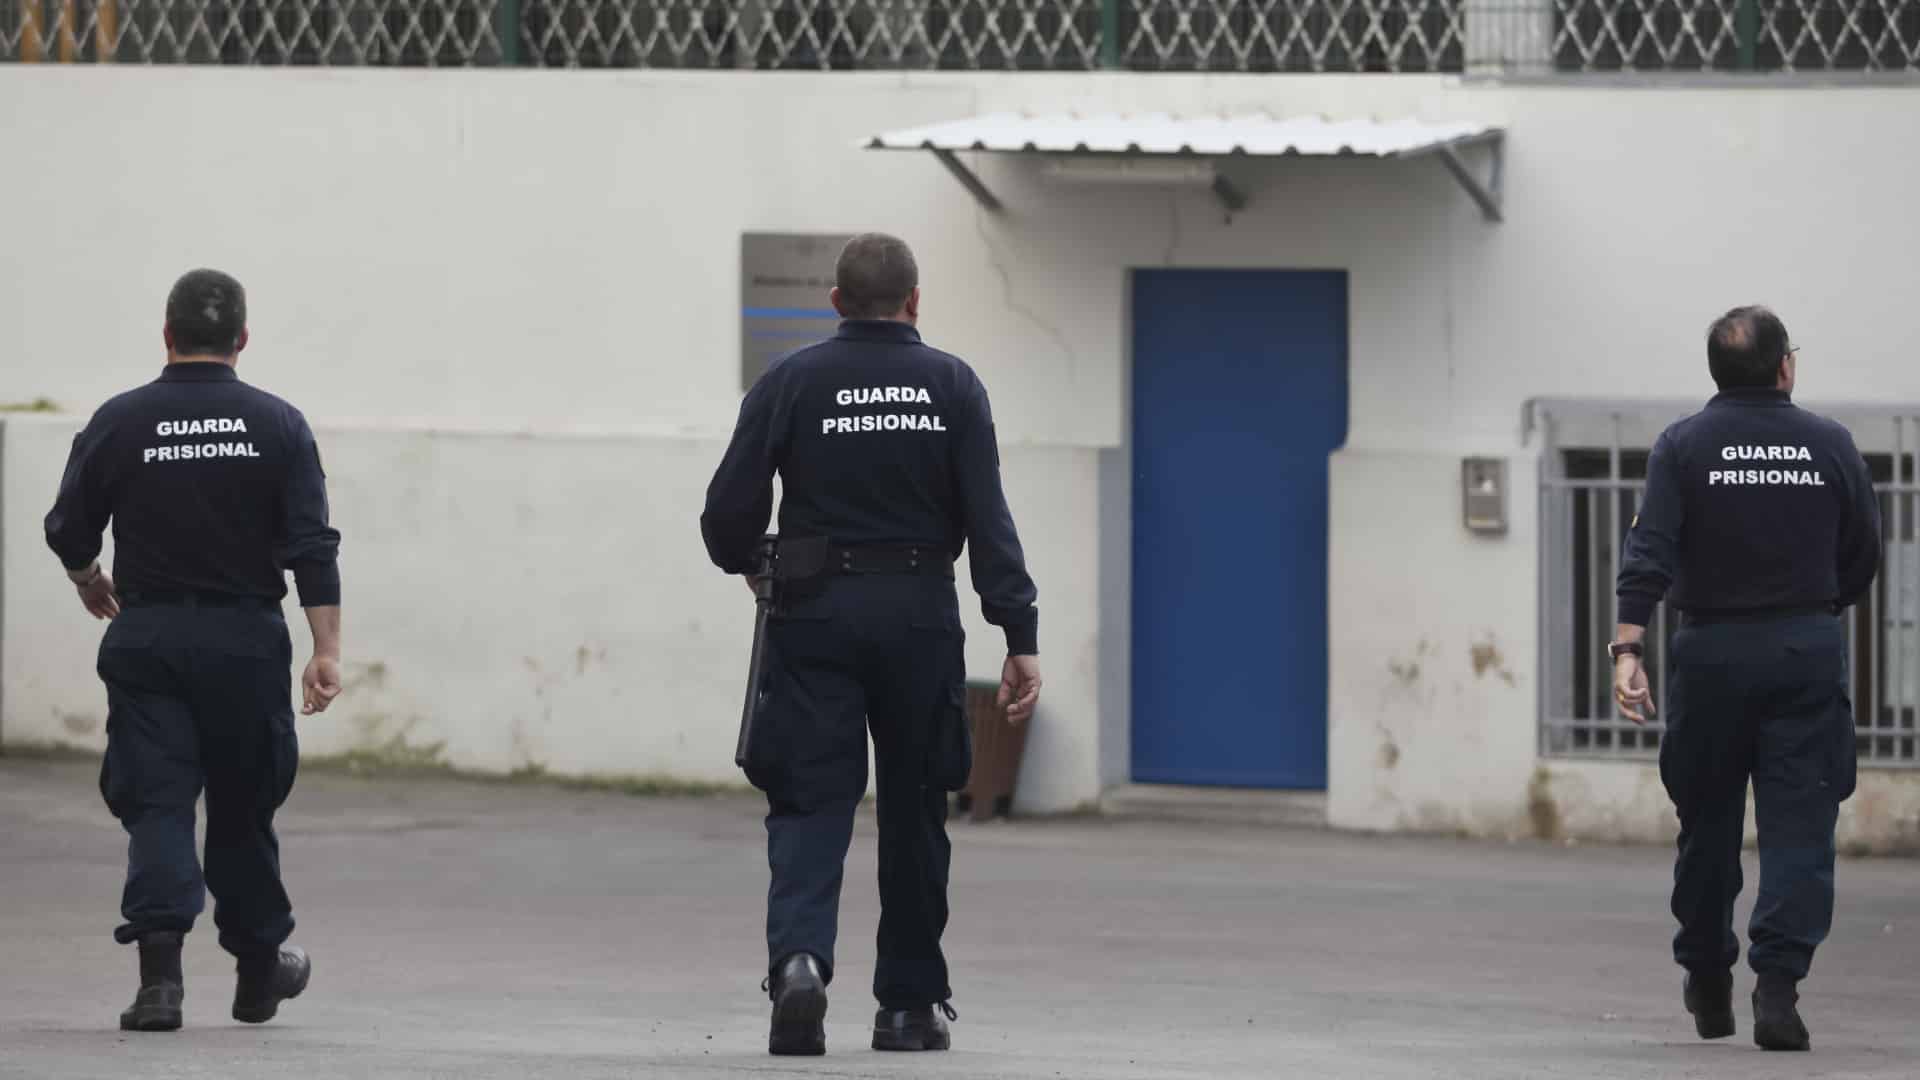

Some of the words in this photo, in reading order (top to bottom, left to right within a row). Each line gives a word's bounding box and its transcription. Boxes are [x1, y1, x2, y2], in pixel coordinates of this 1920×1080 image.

[836, 387, 932, 405] GUARDA
[156, 418, 247, 437] GUARDA
[822, 414, 947, 434] PRISIONAL
[143, 443, 260, 463] PRISIONAL
[1721, 445, 1812, 461] GUARDA
[1708, 469, 1825, 486] PRISIONAL
